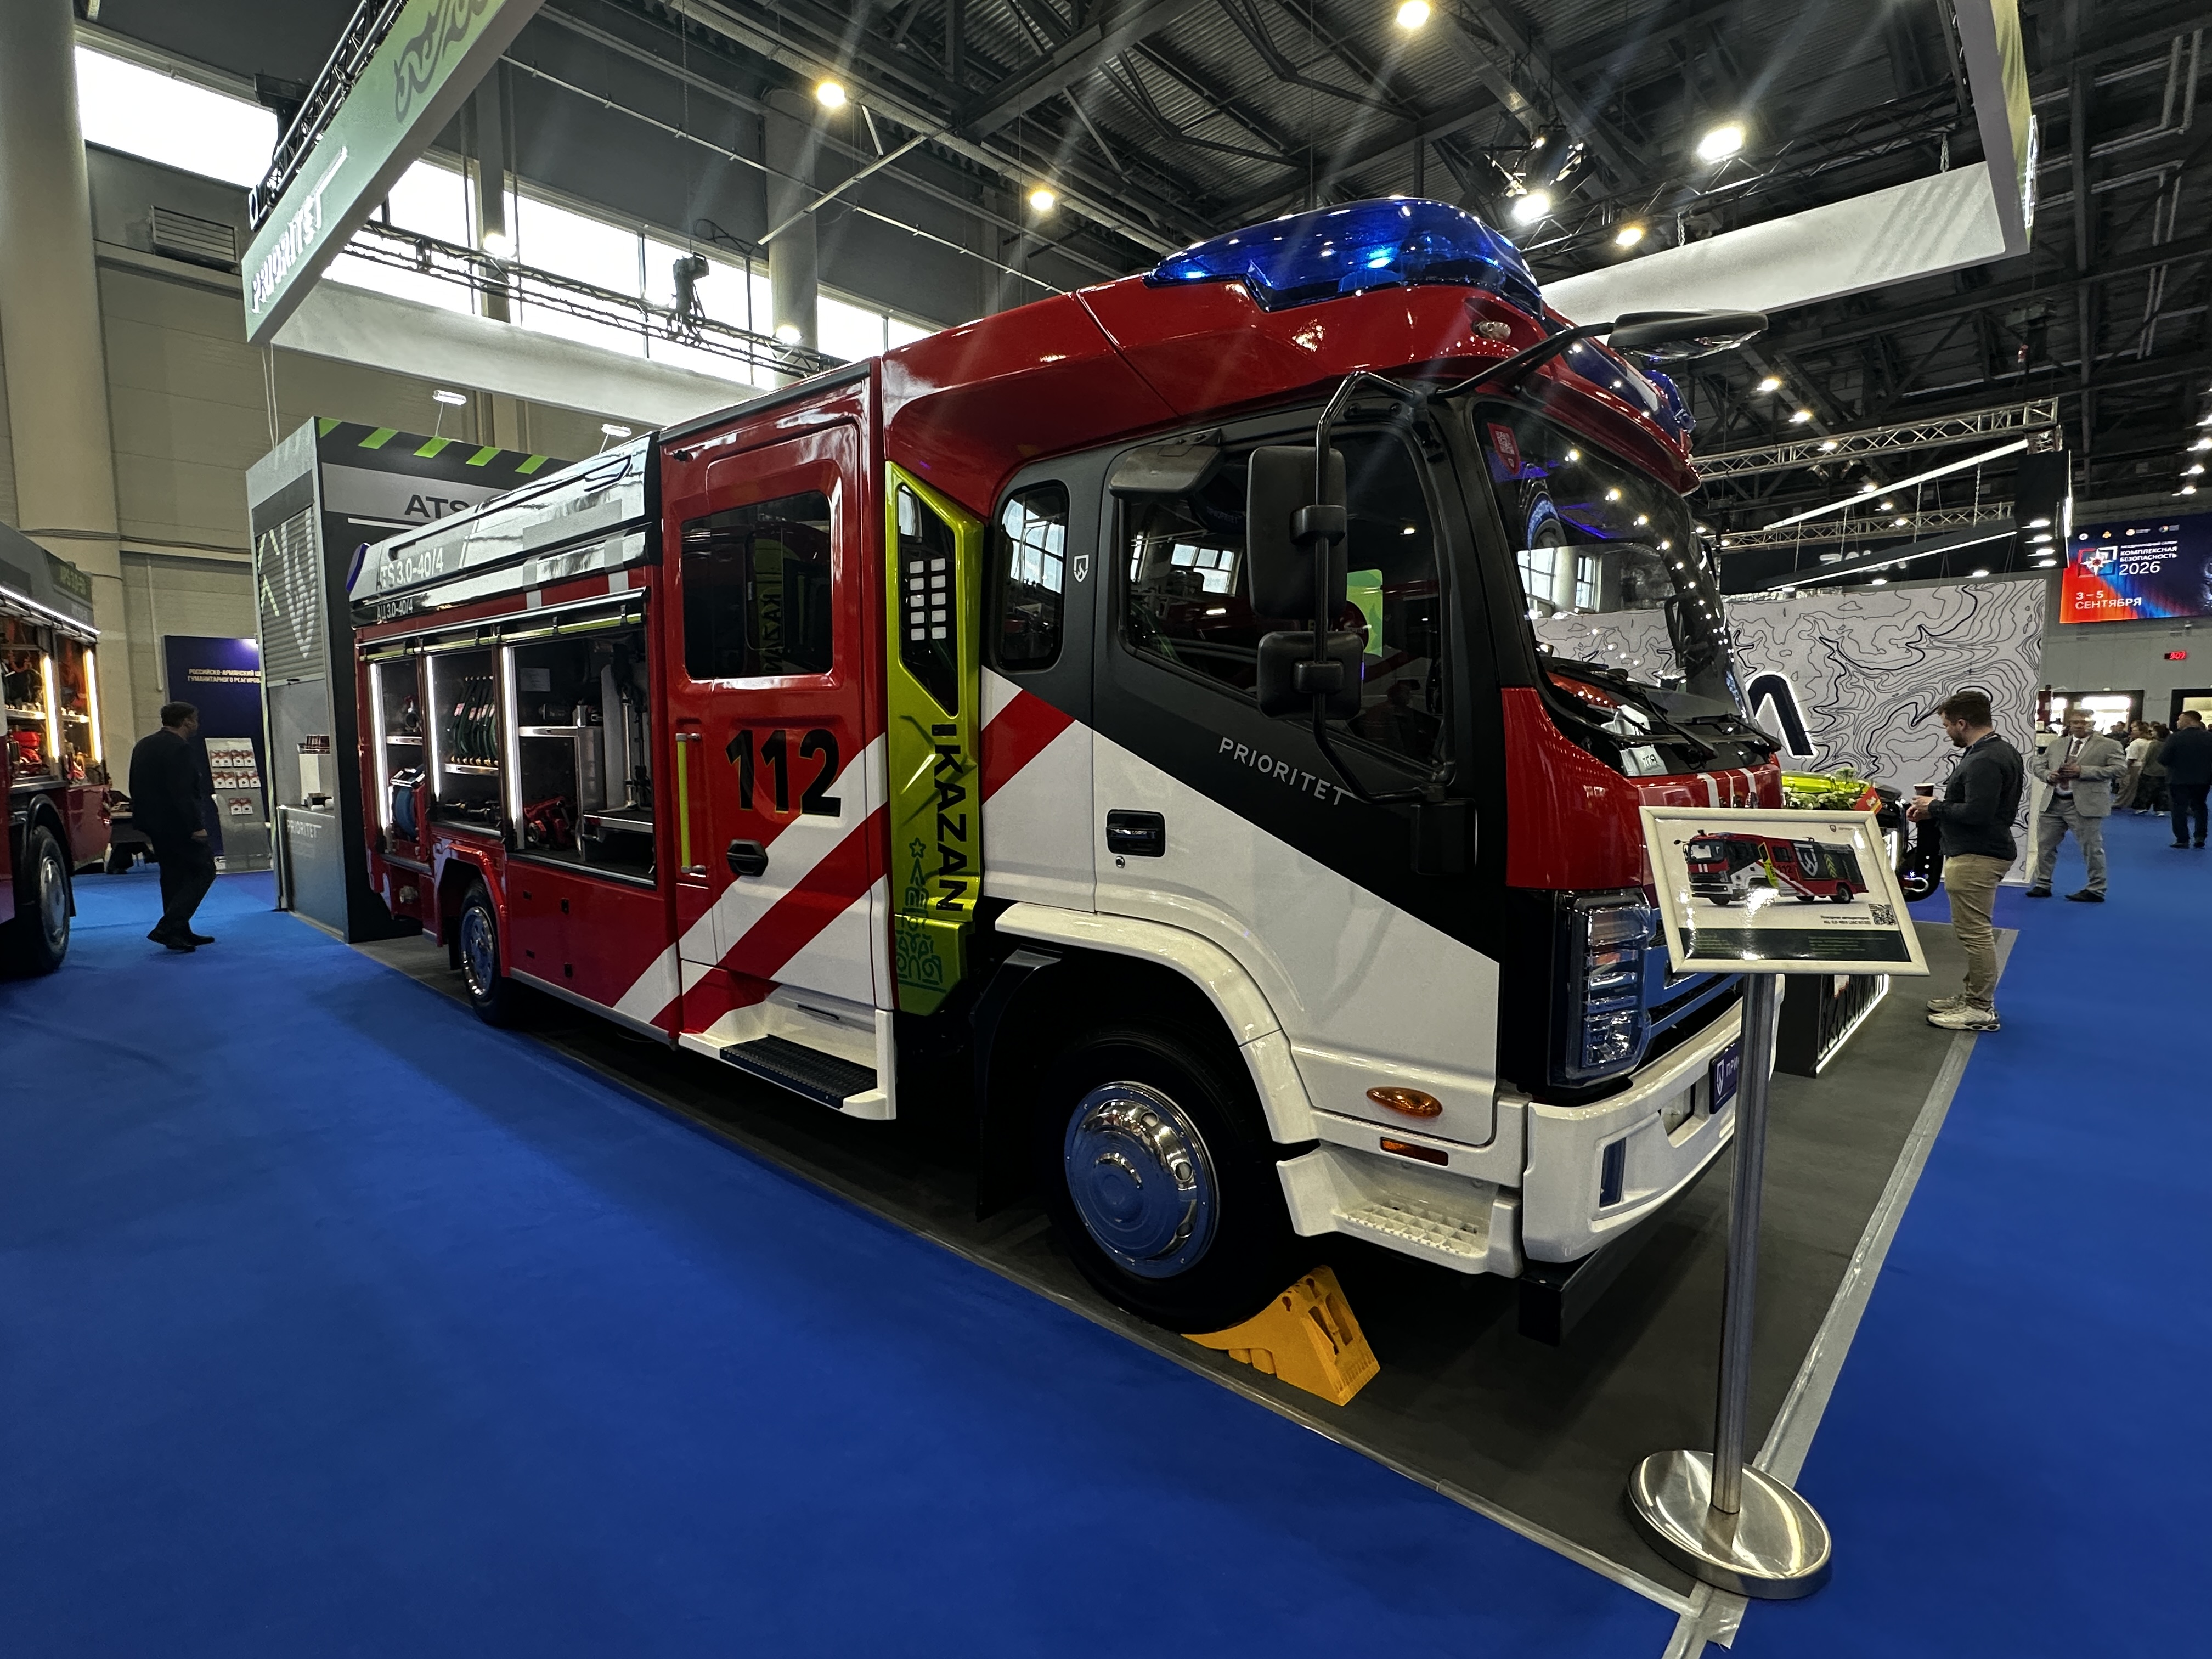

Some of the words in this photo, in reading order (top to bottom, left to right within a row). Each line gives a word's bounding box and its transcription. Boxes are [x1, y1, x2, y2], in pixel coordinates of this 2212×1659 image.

[2119, 553, 2177, 562] БЕЗОПАСНОСТЬ
[2120, 546, 2177, 556] КОМПЛЕКСНАЯ
[397, 547, 443, 585] 3.0-40/4
[2119, 561, 2160, 576] 2026
[2075, 591, 2084, 600] 3
[2096, 590, 2104, 599] 5
[2075, 597, 2142, 610] СЕНТЯБРЯ
[725, 729, 841, 817] 112
[1218, 737, 1355, 805] PRIORITET
